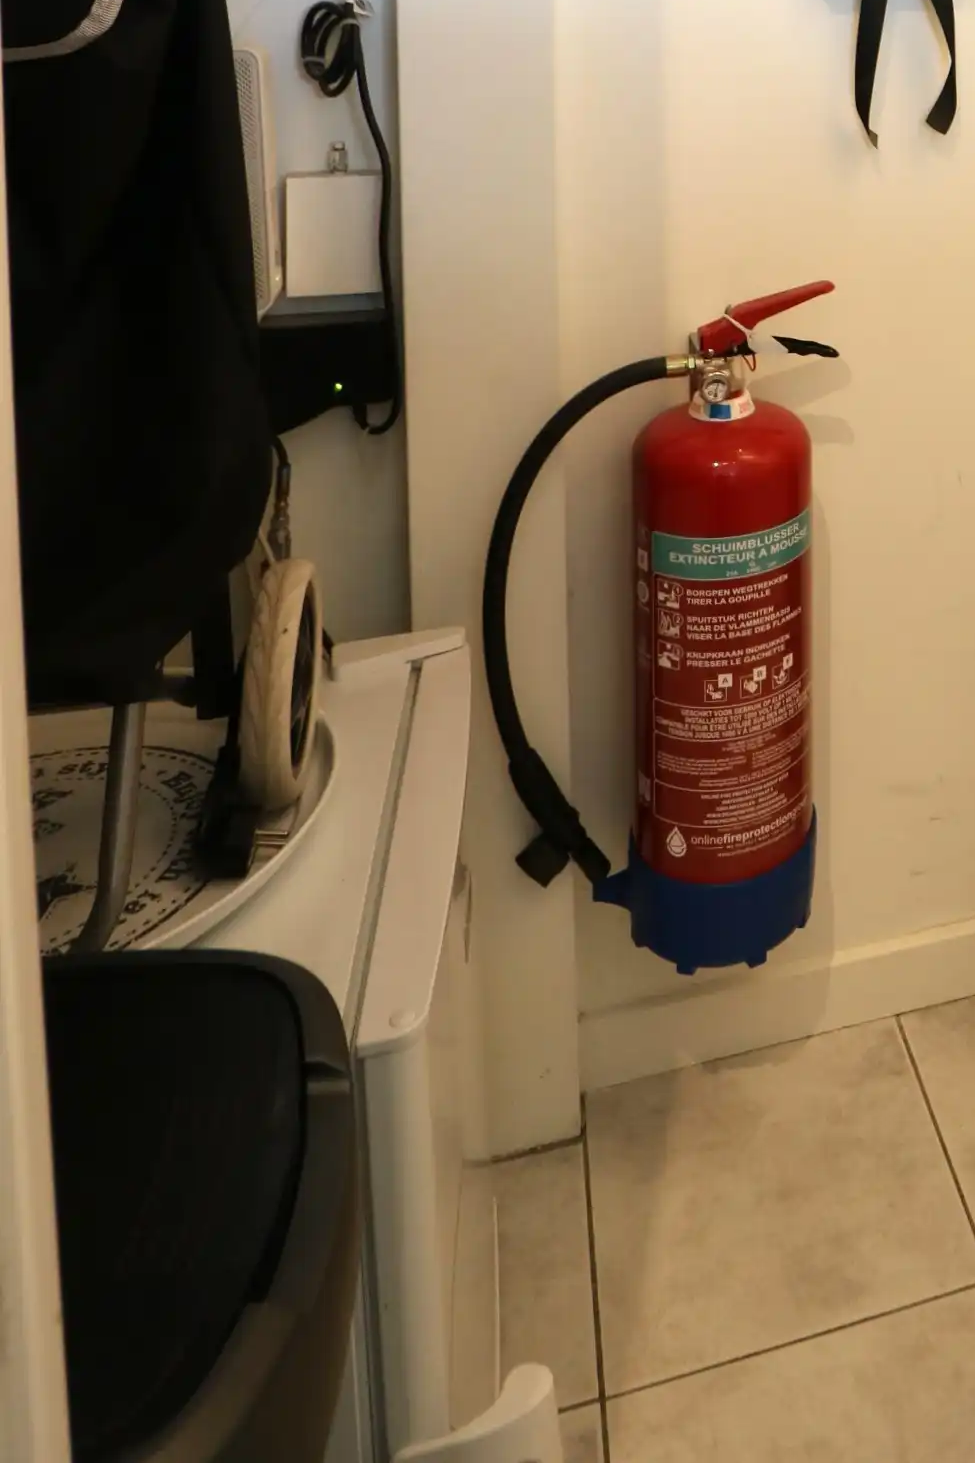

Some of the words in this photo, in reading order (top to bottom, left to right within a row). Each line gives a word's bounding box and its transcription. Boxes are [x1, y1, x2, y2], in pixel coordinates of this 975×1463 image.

[691, 522, 800, 554] SCHUIMBLUSSER
[668, 548, 756, 565] EXTINCTEUR
[686, 587, 730, 597] BORGPEN
[732, 573, 788, 596] WEGTREKKEN
[686, 597, 712, 606] TIRER
[714, 596, 726, 606] LA
[728, 588, 771, 604] GOUPILLE
[686, 615, 736, 624] SPUITSTUK
[738, 605, 774, 621] RICHTEN
[686, 623, 712, 633] NAAR
[713, 623, 726, 632] DE
[728, 605, 791, 631] VLAMMENBASIS
[686, 632, 713, 641] VISER
[714, 632, 727, 641] LA
[728, 628, 753, 640] BASE
[754, 623, 771, 635] DES
[686, 659, 729, 668] PRESSER
[730, 657, 741, 666] LE
